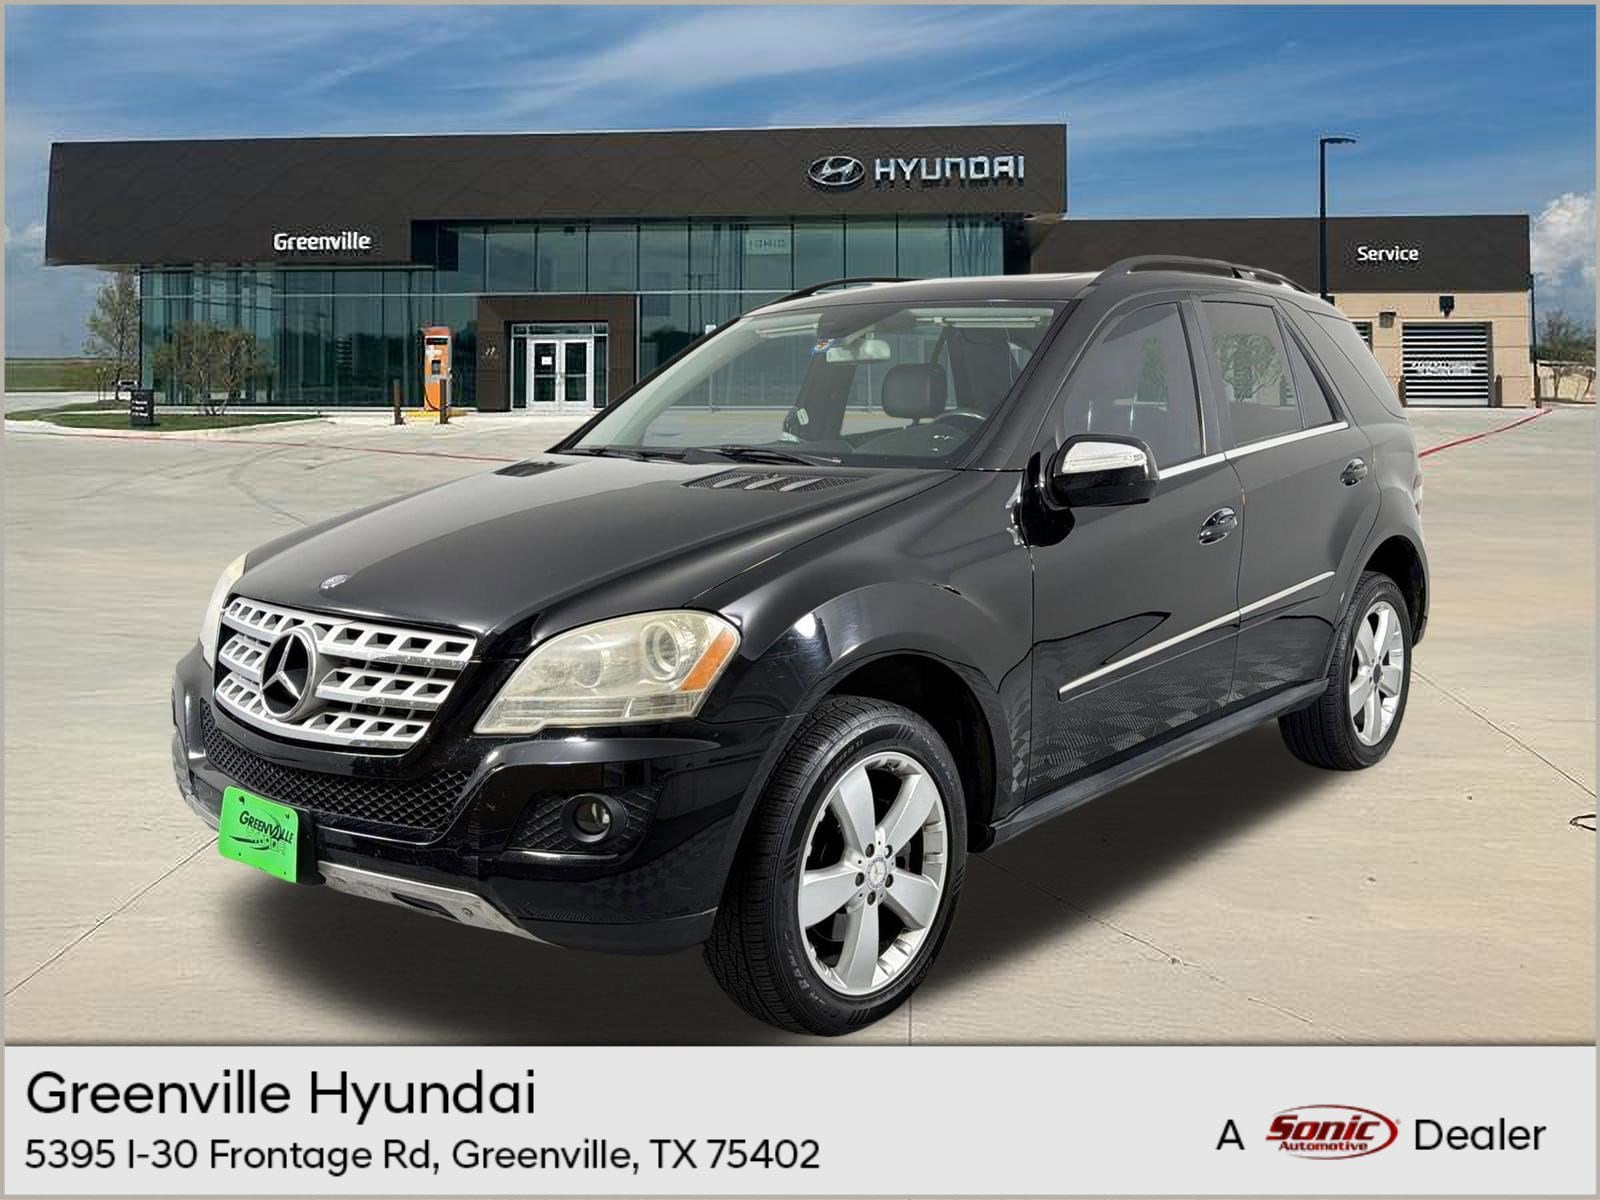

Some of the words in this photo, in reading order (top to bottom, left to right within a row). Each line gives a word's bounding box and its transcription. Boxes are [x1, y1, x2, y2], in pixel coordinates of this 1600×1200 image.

[874, 155, 1025, 181] HYUNDAI
[273, 231, 372, 251] Greenville
[1357, 245, 1419, 261] Service
